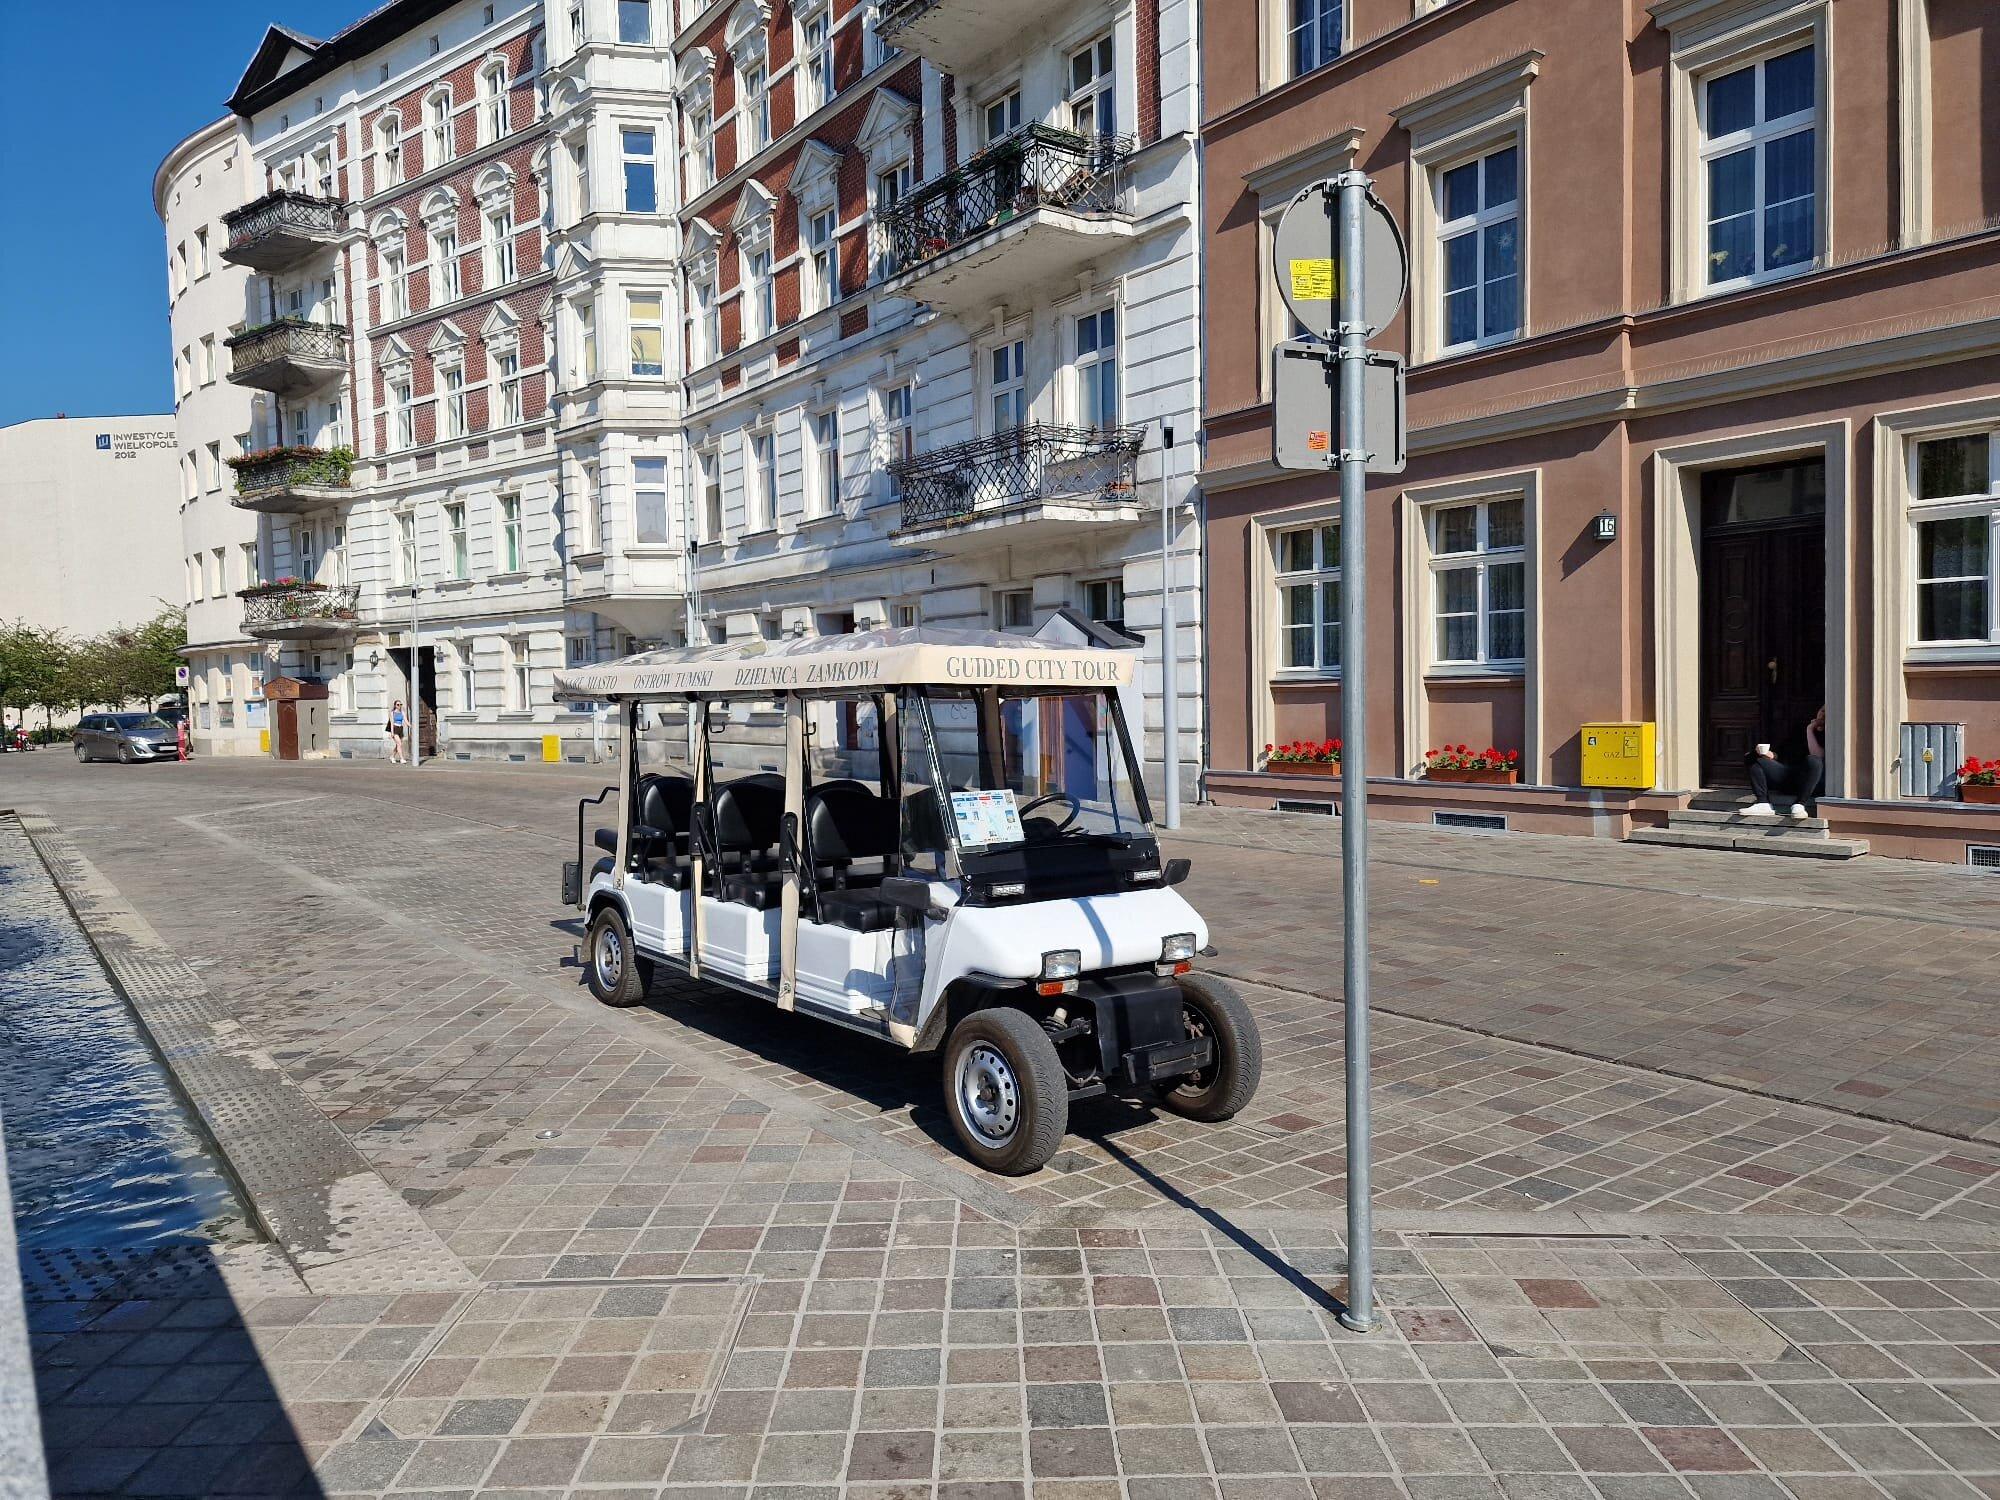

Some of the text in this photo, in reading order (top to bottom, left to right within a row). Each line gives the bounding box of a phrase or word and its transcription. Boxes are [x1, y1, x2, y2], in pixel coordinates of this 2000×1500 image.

[113, 431, 176, 441] INWESTYCJE
[114, 451, 137, 459] 2012
[1600, 519, 1614, 531] 16
[734, 659, 881, 686] DZIELNICA ZAMKOWA
[946, 656, 1121, 681] GUIDED CITY TOUR
[587, 675, 618, 689] MIASTO
[633, 669, 714, 689] OSTRÓW TUMSKI
